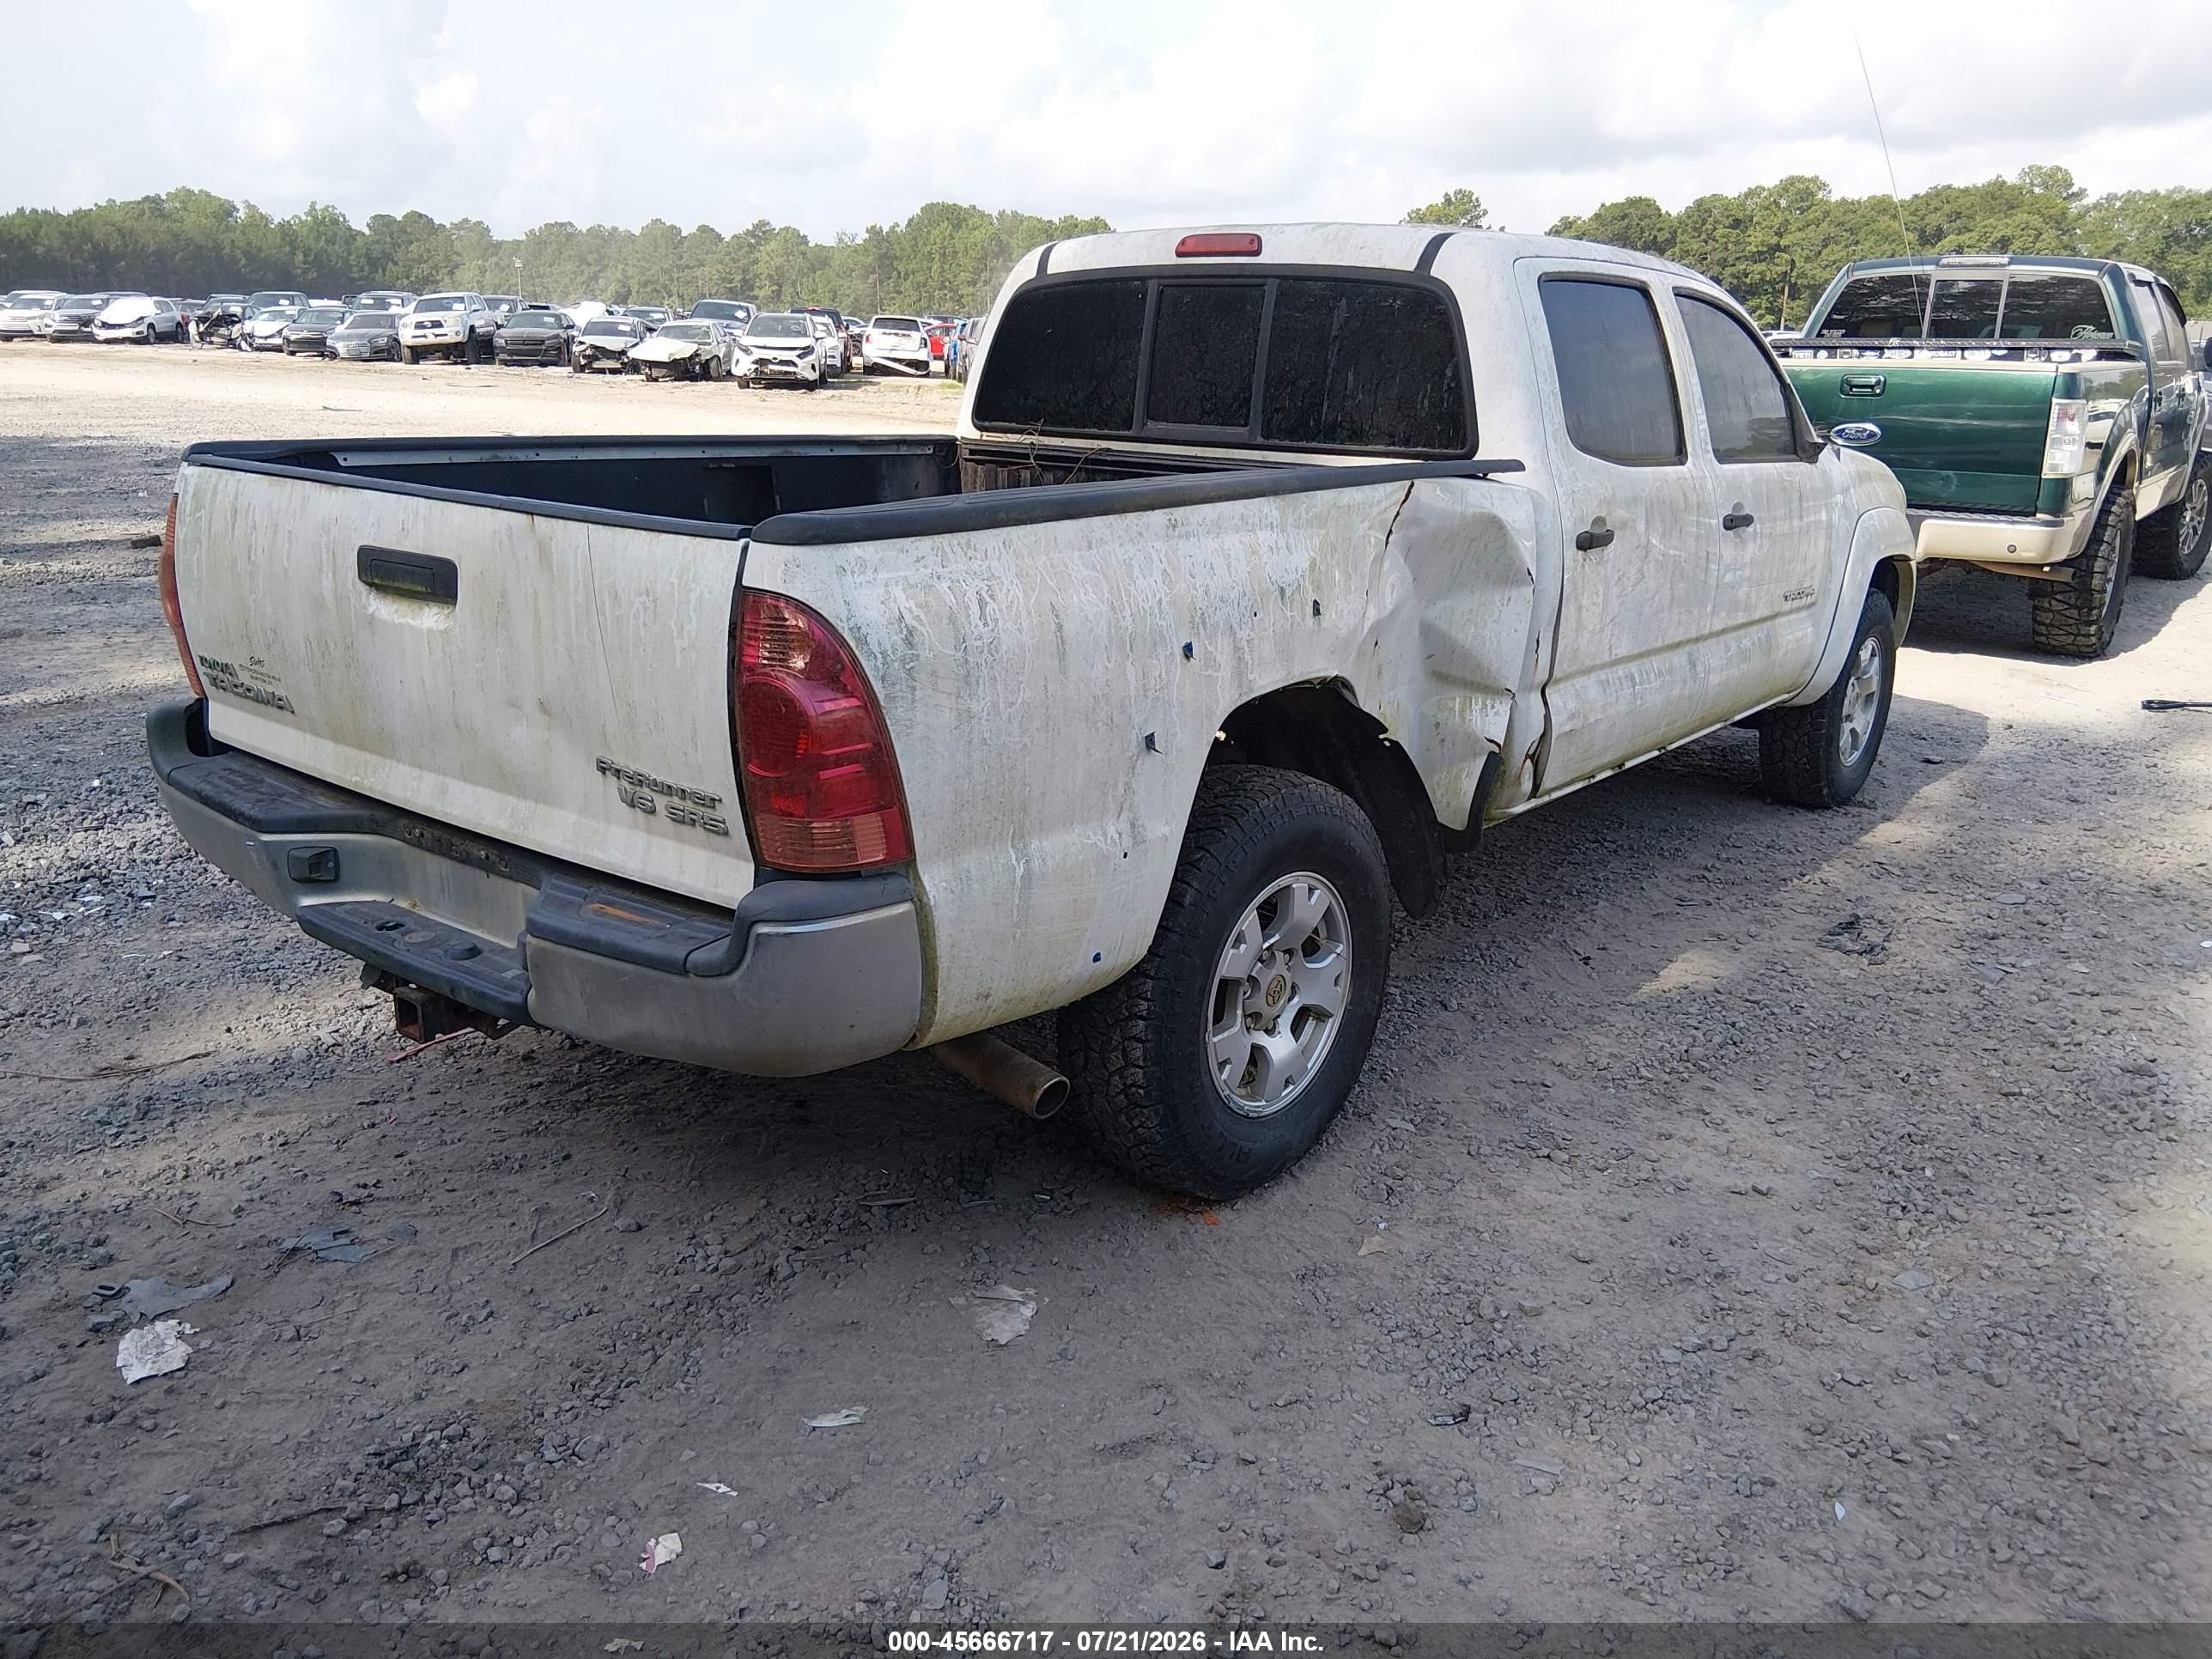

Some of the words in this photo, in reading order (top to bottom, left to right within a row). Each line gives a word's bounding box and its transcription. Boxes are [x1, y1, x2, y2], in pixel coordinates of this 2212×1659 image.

[1842, 427, 1870, 440] Ford
[197, 653, 240, 681] TOYOTA
[203, 671, 295, 714] TACOMA
[595, 755, 723, 808] PreRunner
[617, 785, 656, 814] V6
[665, 801, 729, 835] SR5
